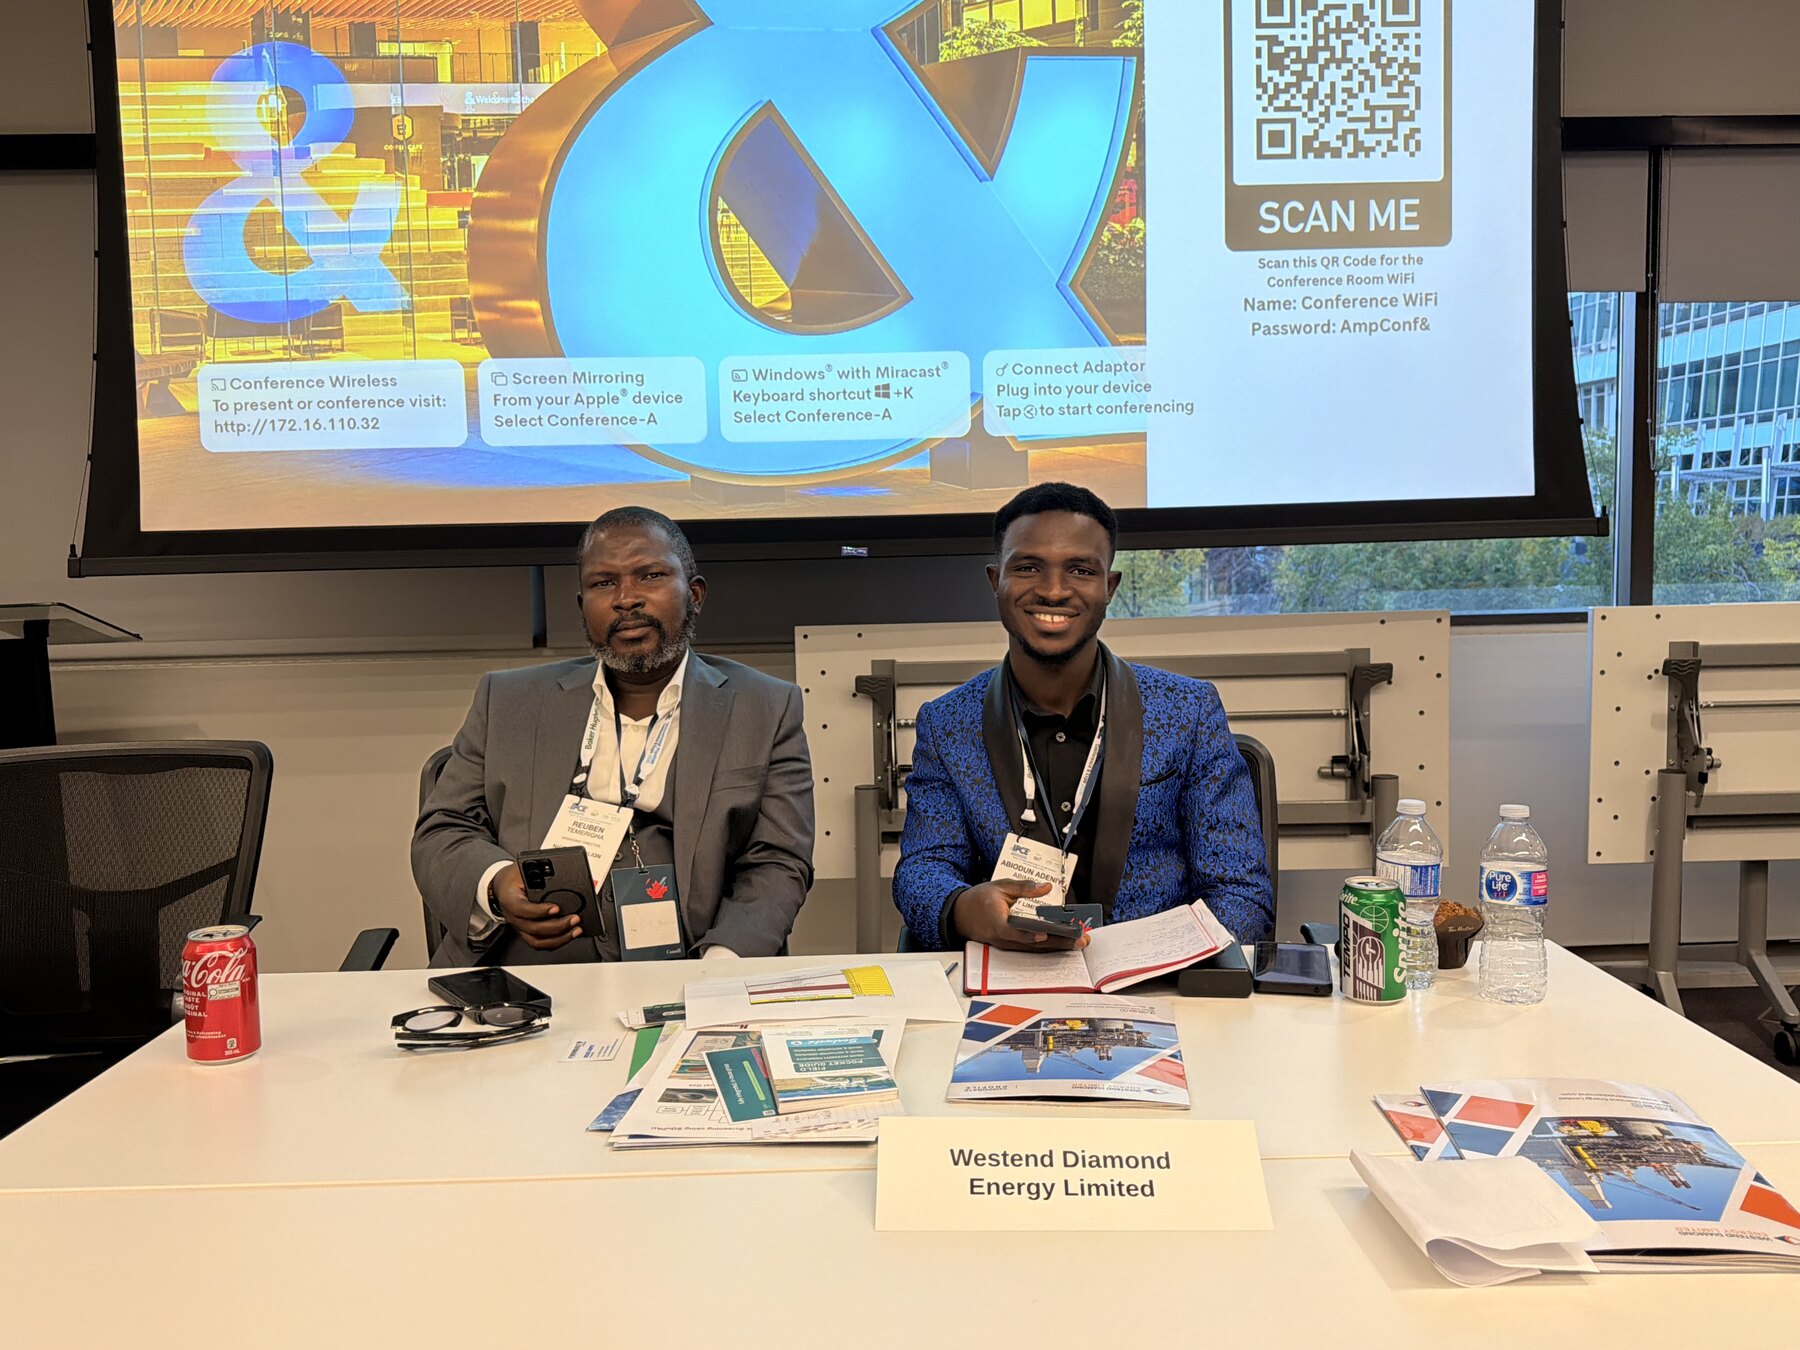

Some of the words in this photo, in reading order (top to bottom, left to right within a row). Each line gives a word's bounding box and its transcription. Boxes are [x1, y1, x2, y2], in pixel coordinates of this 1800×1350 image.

[1258, 200, 1355, 234] SCAN
[1369, 198, 1420, 232] ME
[1258, 257, 1289, 269] Scan
[1293, 255, 1317, 268] this
[1320, 256, 1339, 269] QR
[1343, 254, 1376, 267] Code
[1380, 254, 1398, 266] for
[1402, 253, 1424, 266] the
[1266, 275, 1343, 288] Conference
[1346, 274, 1384, 286] Room
[1387, 272, 1415, 284] WiFi
[1243, 297, 1297, 312] Name:
[1301, 294, 1399, 310] Conference
[1403, 292, 1438, 307] WiFi
[1251, 320, 1336, 336] Password:
[1340, 317, 1430, 336] AmpConf&
[837, 366, 871, 379] with
[1012, 362, 1079, 375] Connect
[1082, 360, 1146, 376] Adaptor
[230, 376, 325, 391] Conference
[329, 373, 398, 389] Wireless
[512, 372, 567, 385] Screen
[572, 371, 645, 387] Mirroring
[733, 388, 804, 406] Keyboard
[809, 387, 872, 401] shortcut
[893, 386, 914, 400] +K
[996, 382, 1030, 400] Plug
[1034, 382, 1062, 396] into
[1066, 383, 1099, 399] your
[1102, 379, 1152, 394] device
[212, 399, 229, 412] To
[233, 398, 293, 415] present
[299, 399, 313, 410] or
[316, 396, 405, 410] conference
[409, 394, 447, 408] visit:
[493, 393, 532, 406] From
[535, 394, 570, 409] your
[632, 391, 683, 404] device
[733, 411, 781, 424] Select
[785, 408, 893, 422] Conference-A
[996, 404, 1022, 420] Tap
[1039, 404, 1055, 416] to
[1058, 402, 1092, 416] start
[1096, 399, 1194, 416] conferencing
[214, 417, 380, 436] http://172.16.110.32
[494, 415, 543, 427] Select
[547, 412, 658, 427] Conference-A
[584, 729, 595, 750] Baker
[567, 826, 604, 841] TEMERIGHA
[572, 820, 605, 833] REUBEN
[1001, 859, 1034, 876] ABIODUN
[1489, 871, 1511, 882] Pure
[1491, 881, 1509, 891] Life
[1343, 912, 1351, 978] TEMPO
[949, 1149, 1054, 1168] Westend
[1062, 1150, 1171, 1170] Diamond
[969, 1178, 1055, 1200] Energy
[1064, 1179, 1155, 1197] Limited
[1725, 1233, 1773, 1242] WESTEND
